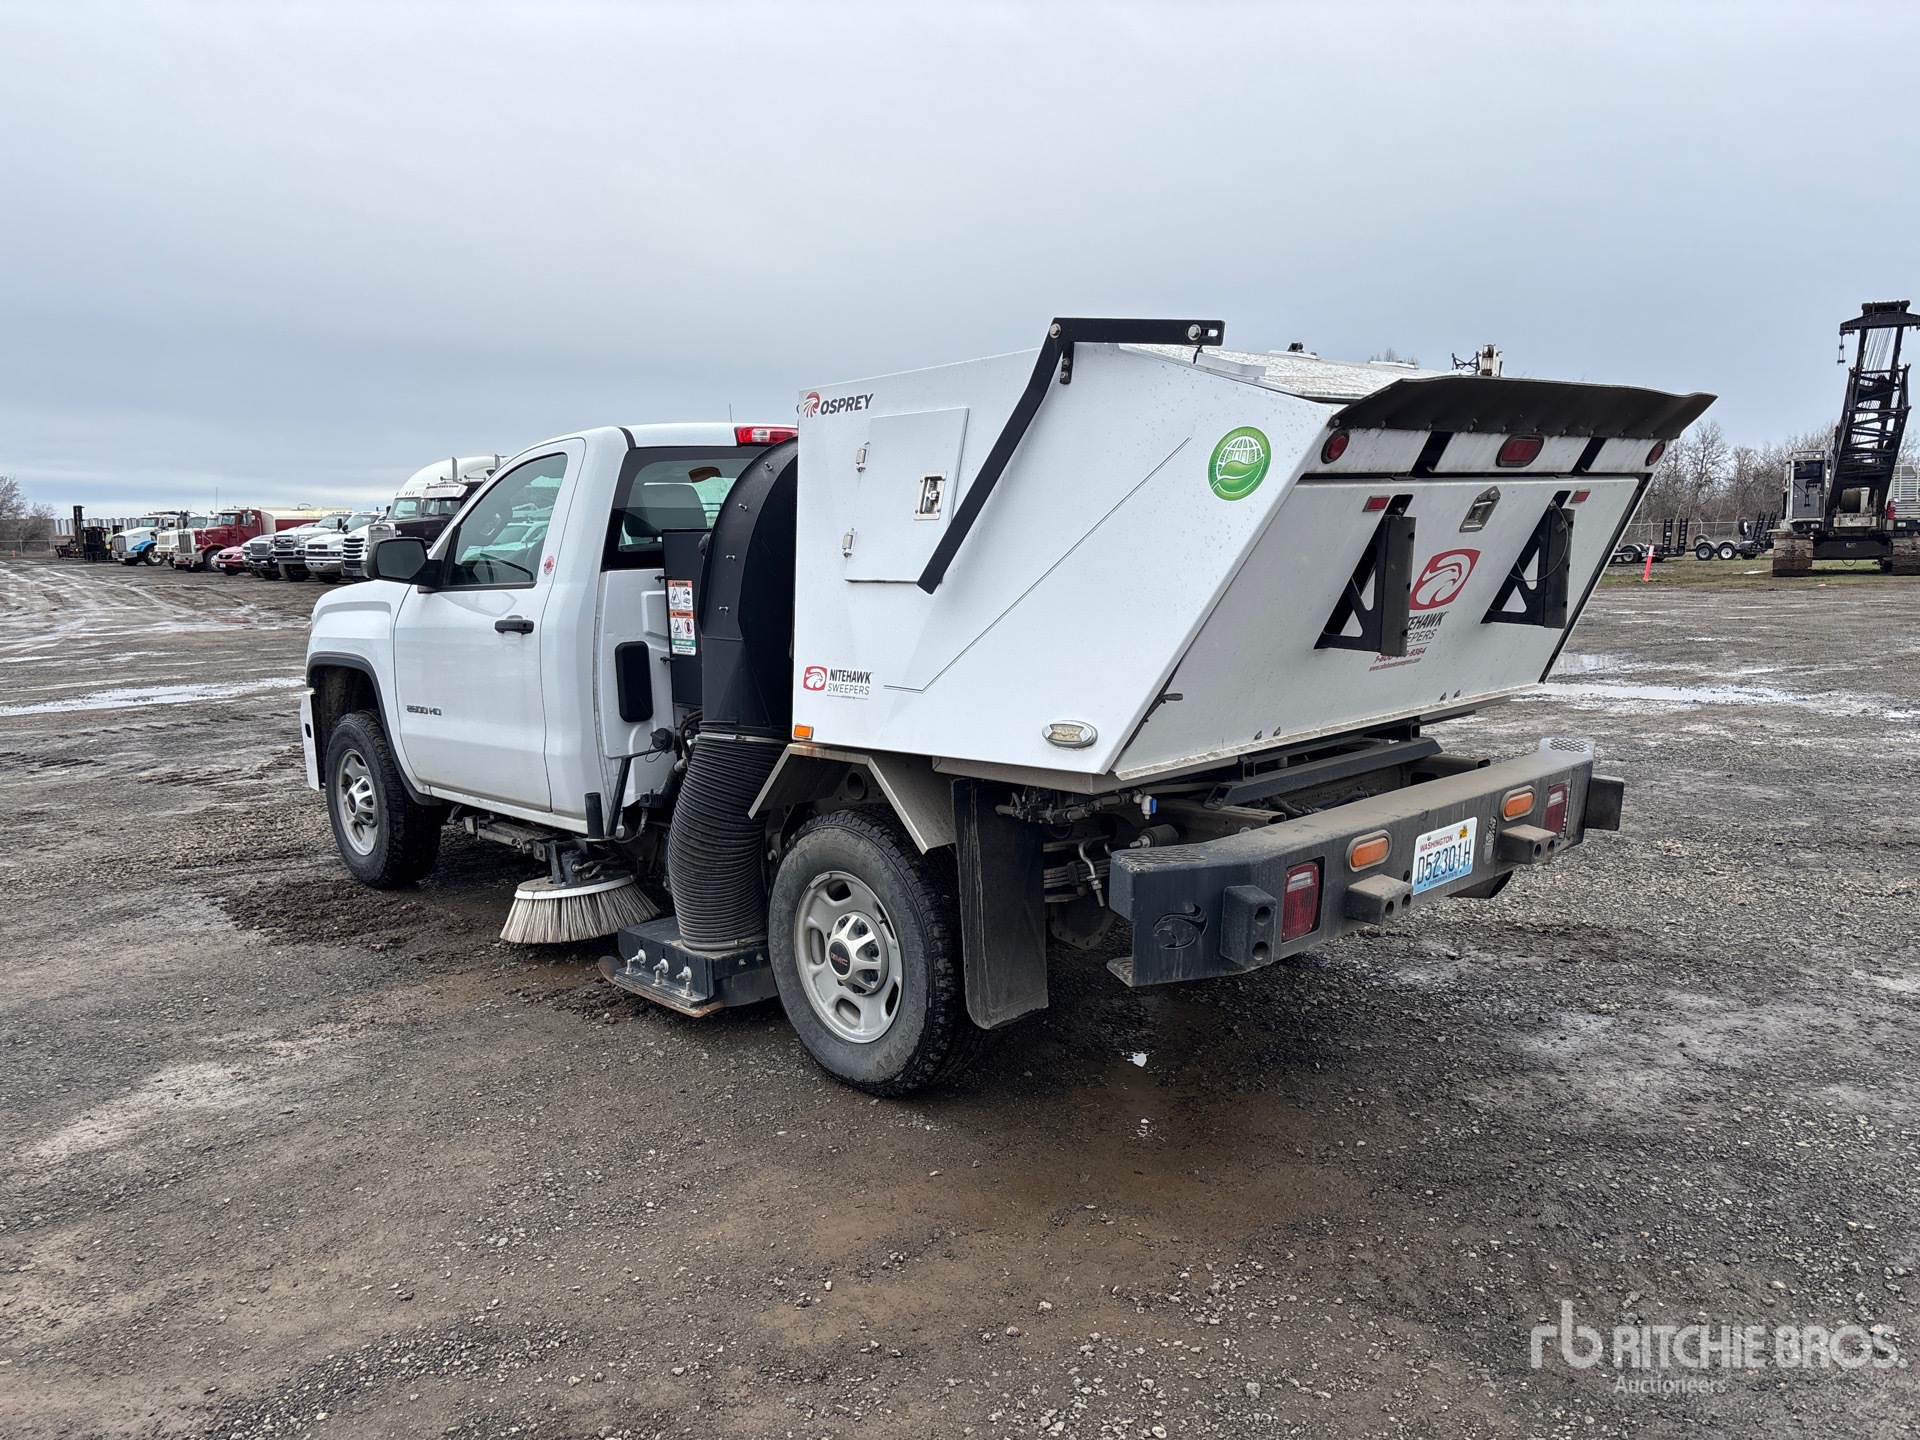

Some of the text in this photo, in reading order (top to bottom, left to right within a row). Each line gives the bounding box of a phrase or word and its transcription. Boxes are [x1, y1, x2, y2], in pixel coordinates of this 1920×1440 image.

[820, 393, 874, 415] OSPREY
[829, 669, 872, 684] NITEHAWK
[827, 683, 870, 695] SWEEPERS
[1420, 835, 1453, 851] WASHINGTON
[830, 952, 849, 966] GMC
